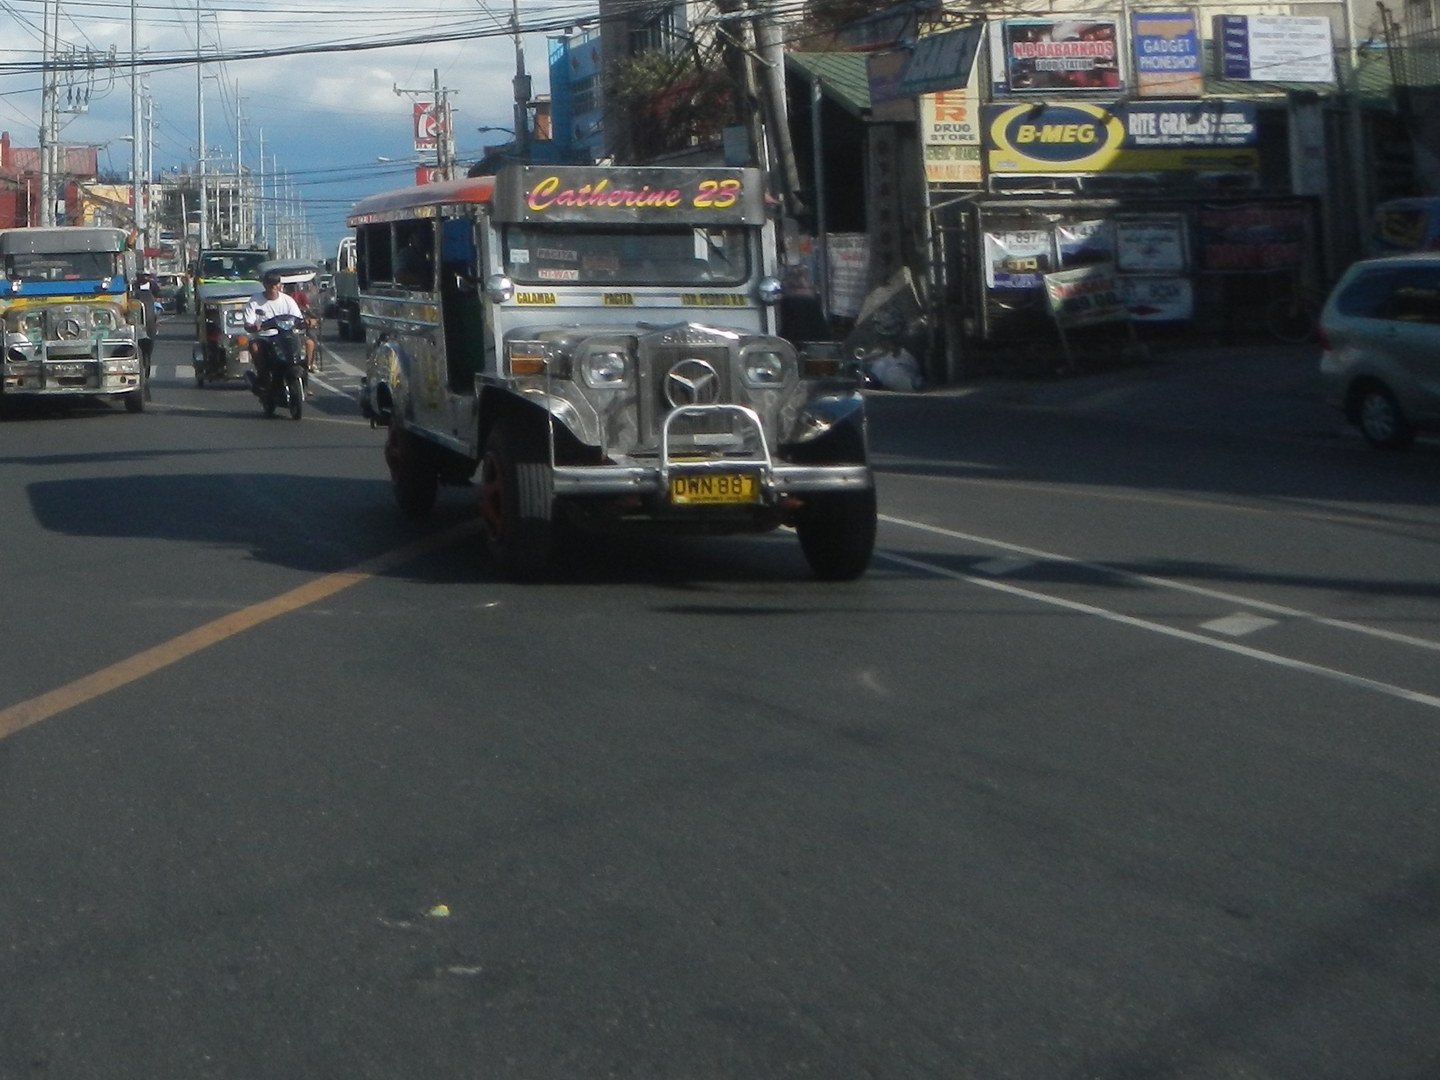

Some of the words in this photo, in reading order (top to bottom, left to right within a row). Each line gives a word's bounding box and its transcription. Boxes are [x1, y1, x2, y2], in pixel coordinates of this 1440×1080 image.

[1143, 39, 1191, 53] GADGET
[1035, 58, 1058, 71] FOOD
[1060, 58, 1095, 71] STATION
[933, 123, 971, 133] DRUG
[1128, 112, 1157, 135] RITE
[930, 133, 976, 142] STORE
[1016, 123, 1096, 144] B-MEG
[527, 176, 683, 211] Catherine
[693, 178, 743, 209] 23
[517, 293, 556, 305] CALAMBA
